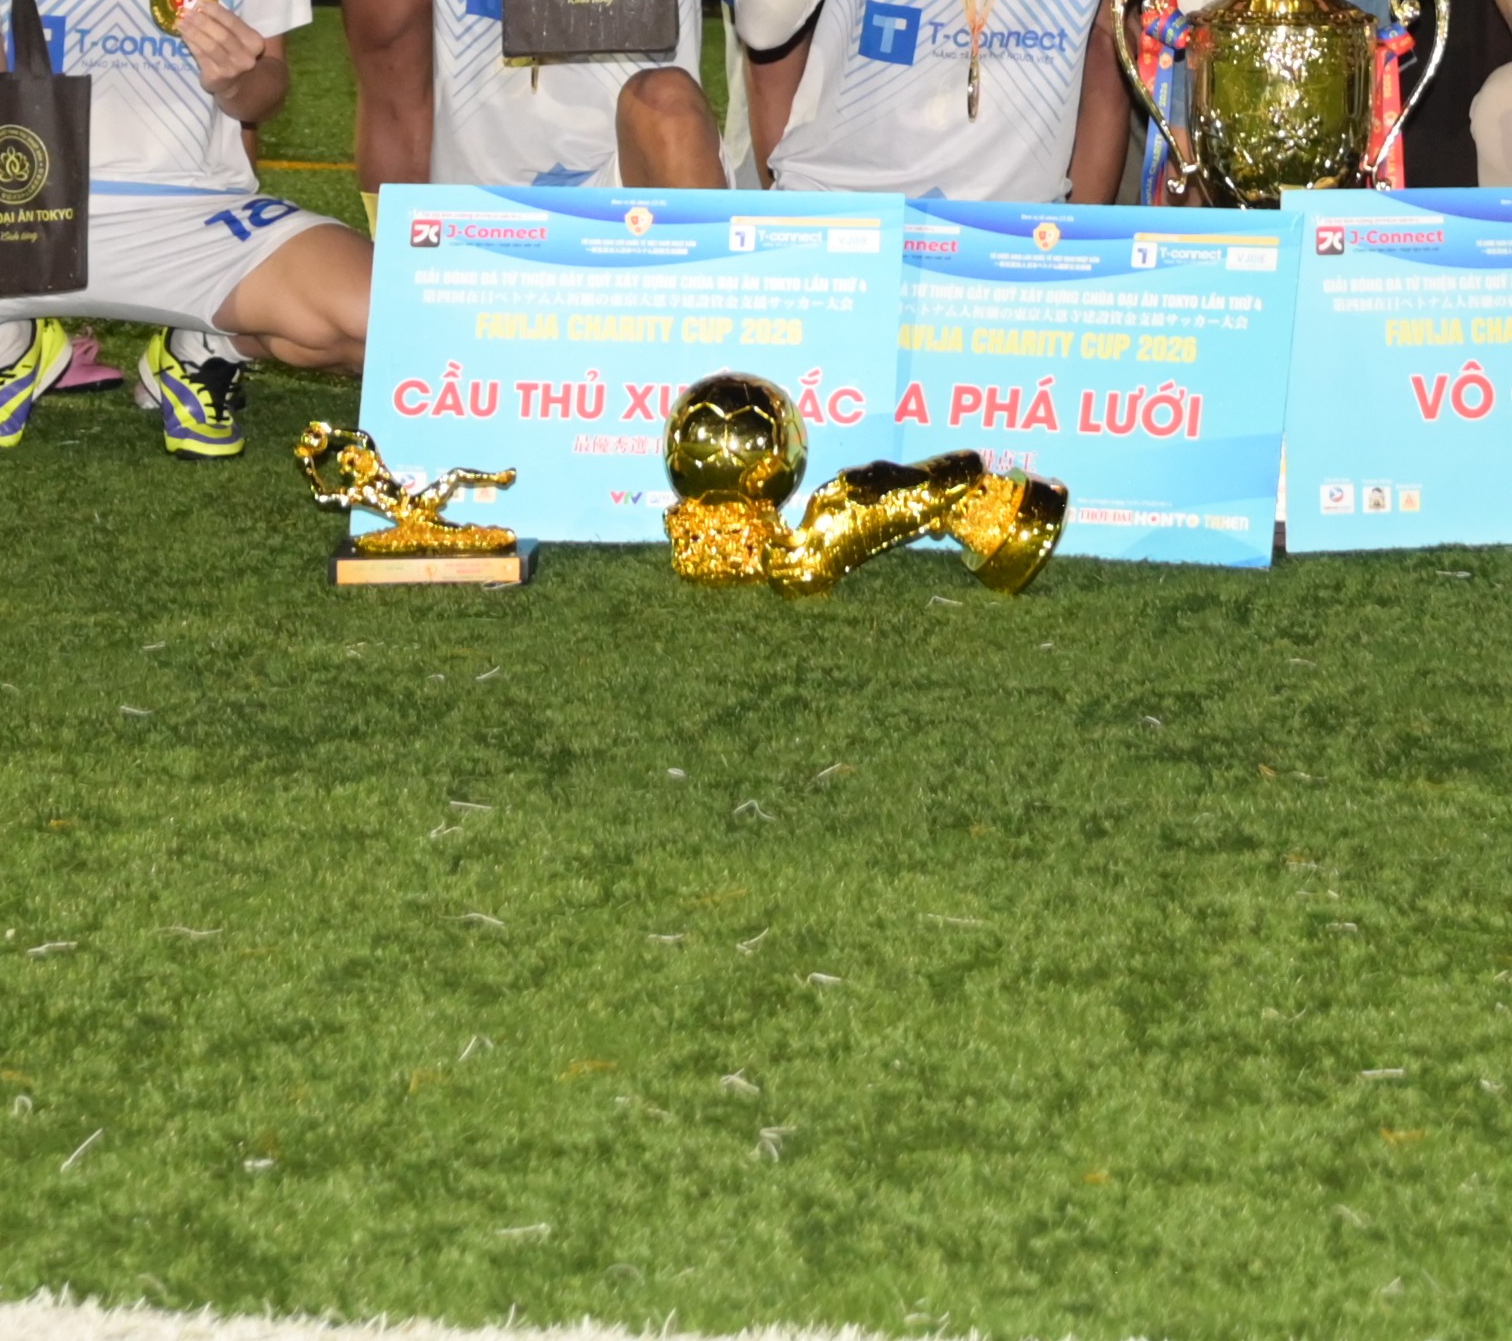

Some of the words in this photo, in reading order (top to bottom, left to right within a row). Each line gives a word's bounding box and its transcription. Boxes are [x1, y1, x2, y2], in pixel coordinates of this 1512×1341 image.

[36, 207, 74, 223] TOKYO
[445, 223, 548, 241] J-Connect
[1348, 228, 1445, 246] J-Connect
[970, 328, 1074, 360] CHARITY
[1081, 332, 1131, 361] CUP
[1135, 334, 1198, 364] 2026
[1385, 316, 1465, 346] FAVIJA
[392, 359, 501, 419] CẦU
[514, 369, 606, 421] THỦ
[1408, 358, 1496, 422] VÔ
[948, 375, 1061, 433] PHÁ
[1076, 380, 1204, 440] LƯỚI
